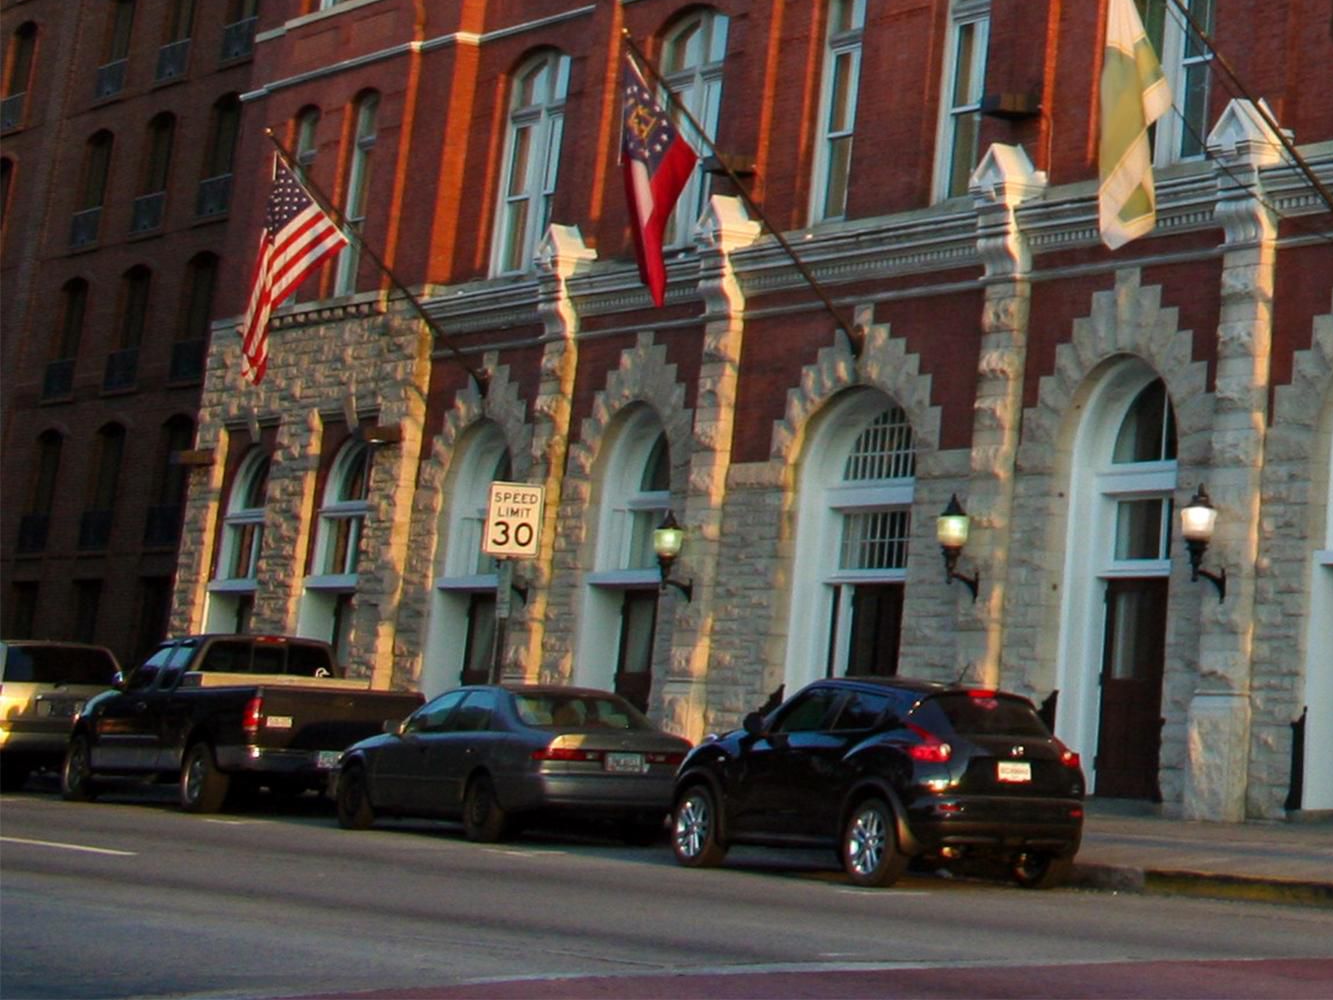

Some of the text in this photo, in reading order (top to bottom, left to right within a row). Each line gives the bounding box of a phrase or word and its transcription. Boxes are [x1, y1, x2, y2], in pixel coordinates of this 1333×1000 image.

[495, 492, 538, 504] SPEED
[498, 506, 531, 518] LIMIT
[492, 521, 533, 547] 30
